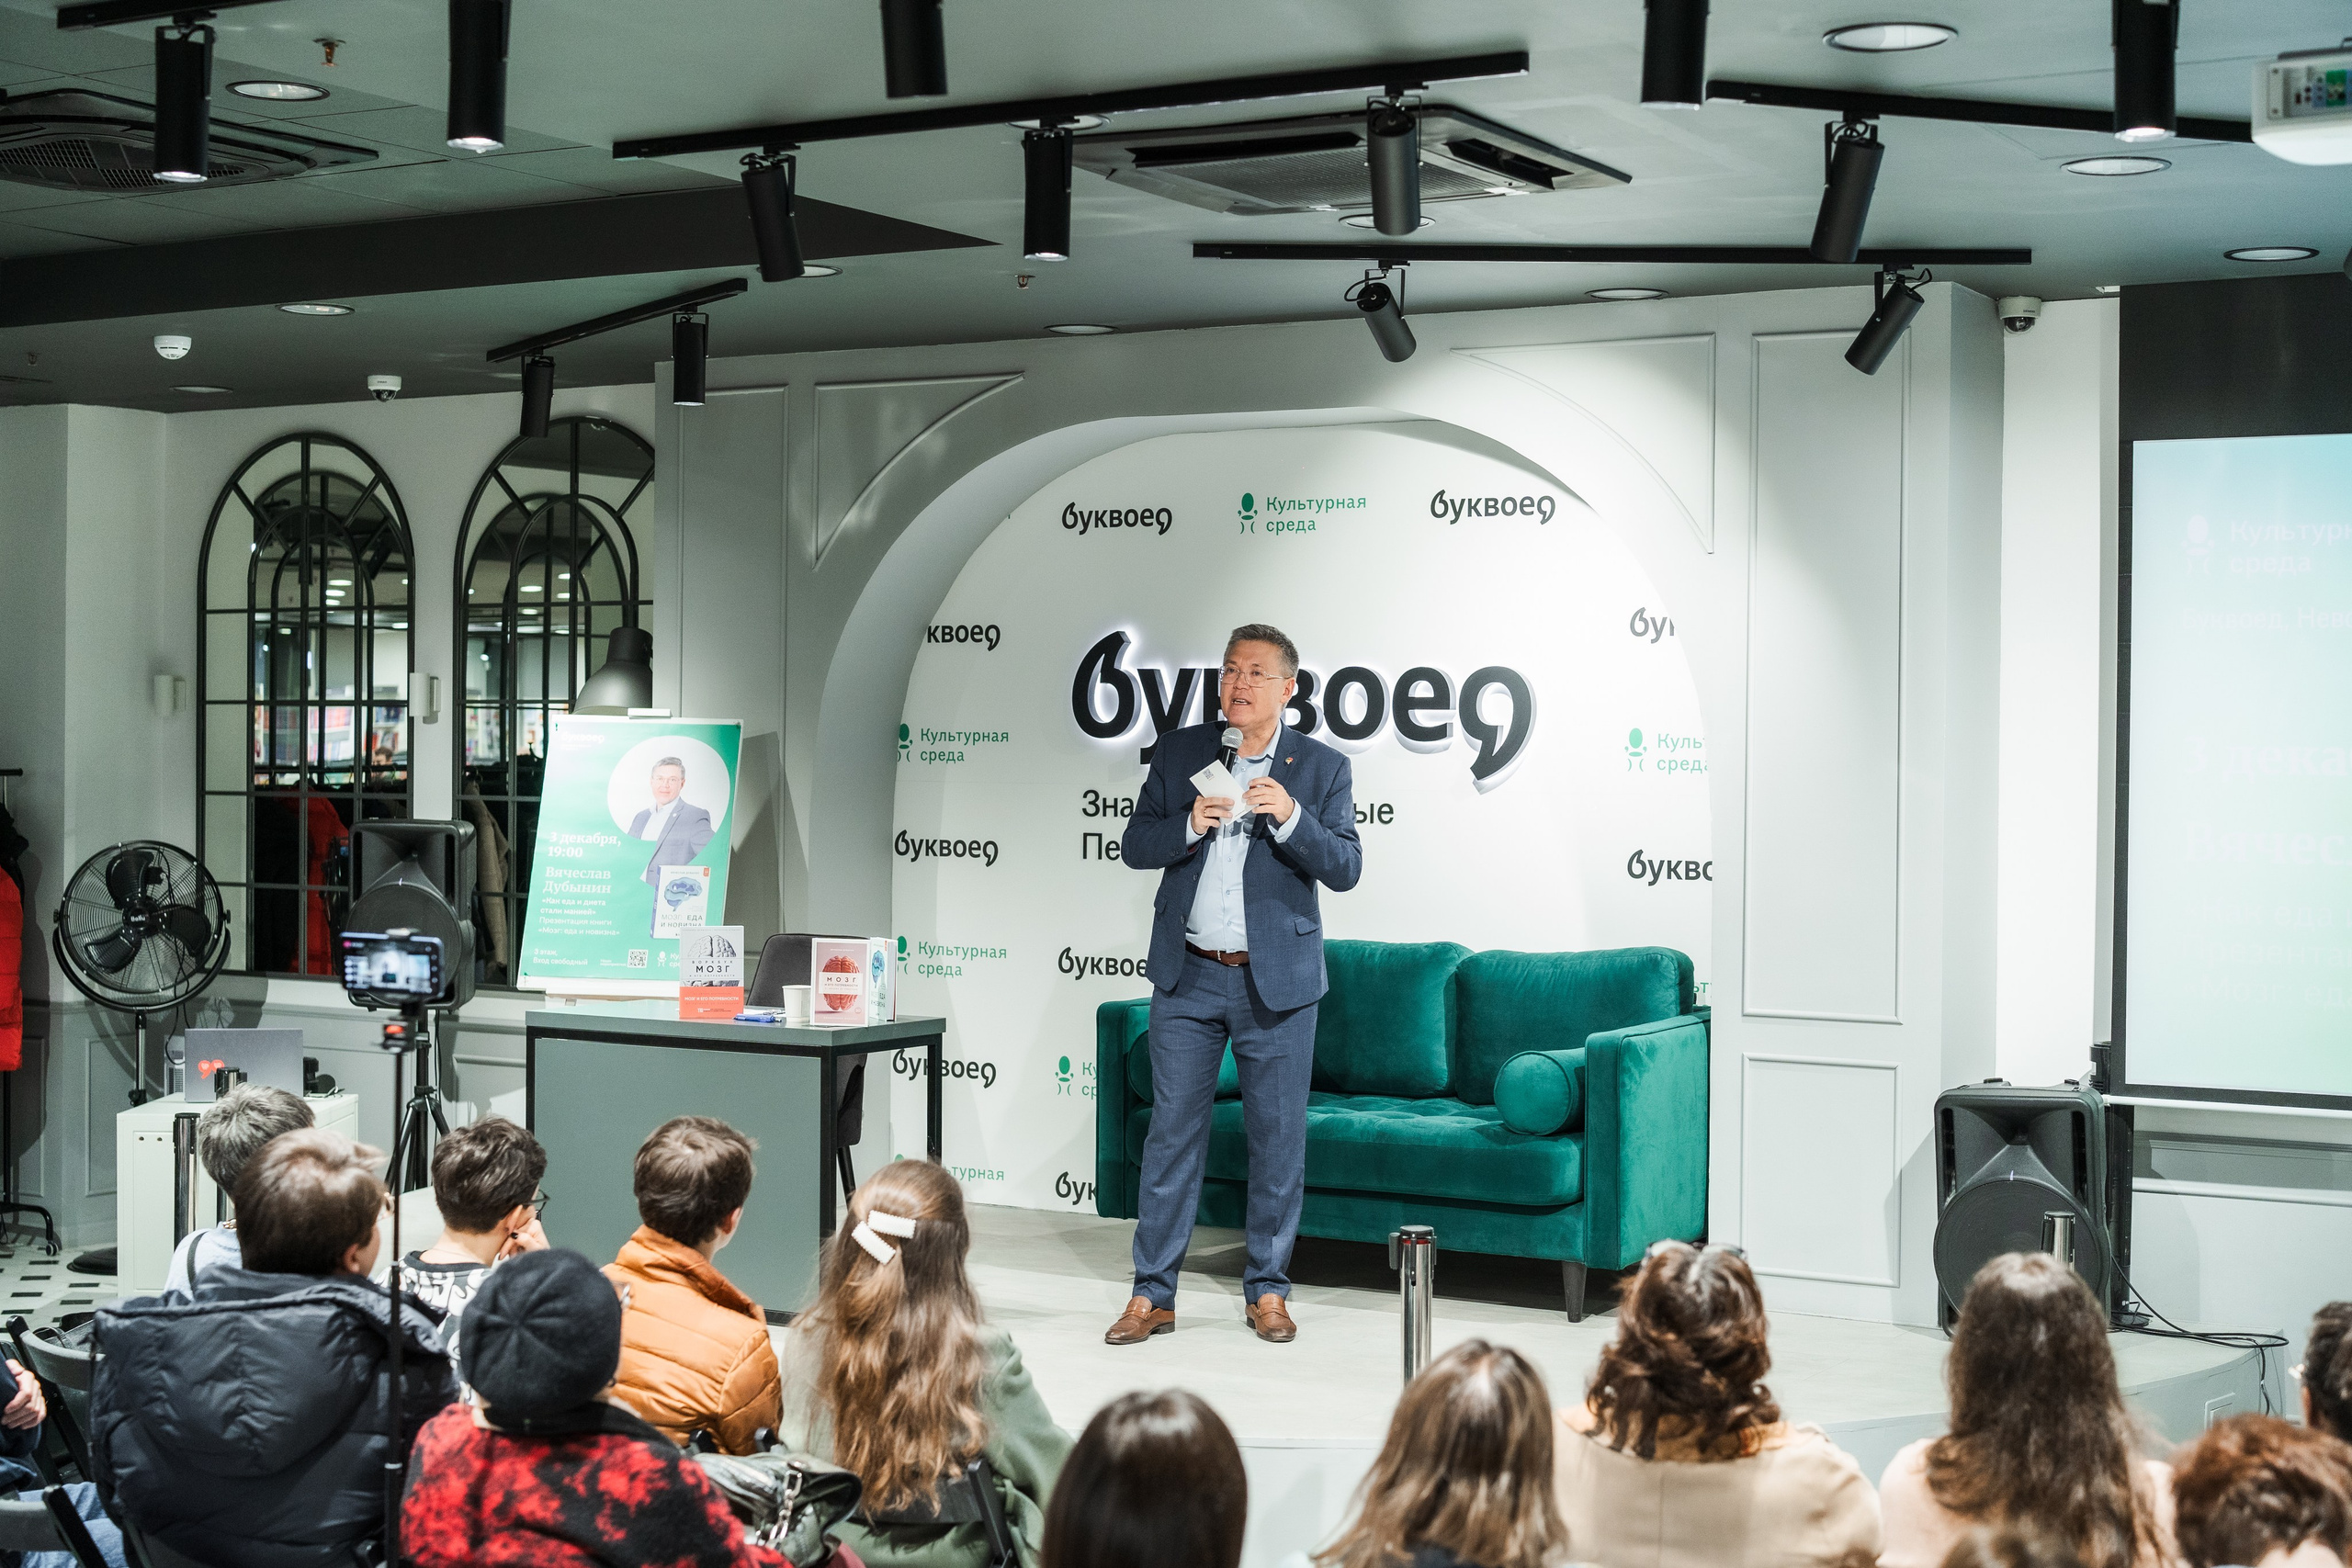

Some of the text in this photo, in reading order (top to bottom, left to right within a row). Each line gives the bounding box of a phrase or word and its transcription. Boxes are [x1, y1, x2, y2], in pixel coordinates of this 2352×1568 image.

[1266, 494, 1366, 512] Культурная
[1430, 490, 1555, 525] буквоед
[1061, 502, 1172, 536] буквоед
[1266, 516, 1317, 535] среда
[921, 728, 1009, 745] Культурная
[1657, 733, 1704, 752] Куль
[921, 750, 965, 764] среда
[2223, 745, 2352, 785] дека
[560, 832, 621, 847] декабря,
[894, 829, 999, 867] буквоед
[2183, 820, 2352, 867] Вячес
[548, 846, 583, 858] 19:00
[545, 866, 611, 879] Вячеслав
[542, 881, 611, 895] Дубынин
[539, 917, 588, 926] Презентация
[919, 941, 1007, 959] Культурная
[695, 964, 730, 974] МОЗГ
[917, 964, 963, 977] среда
